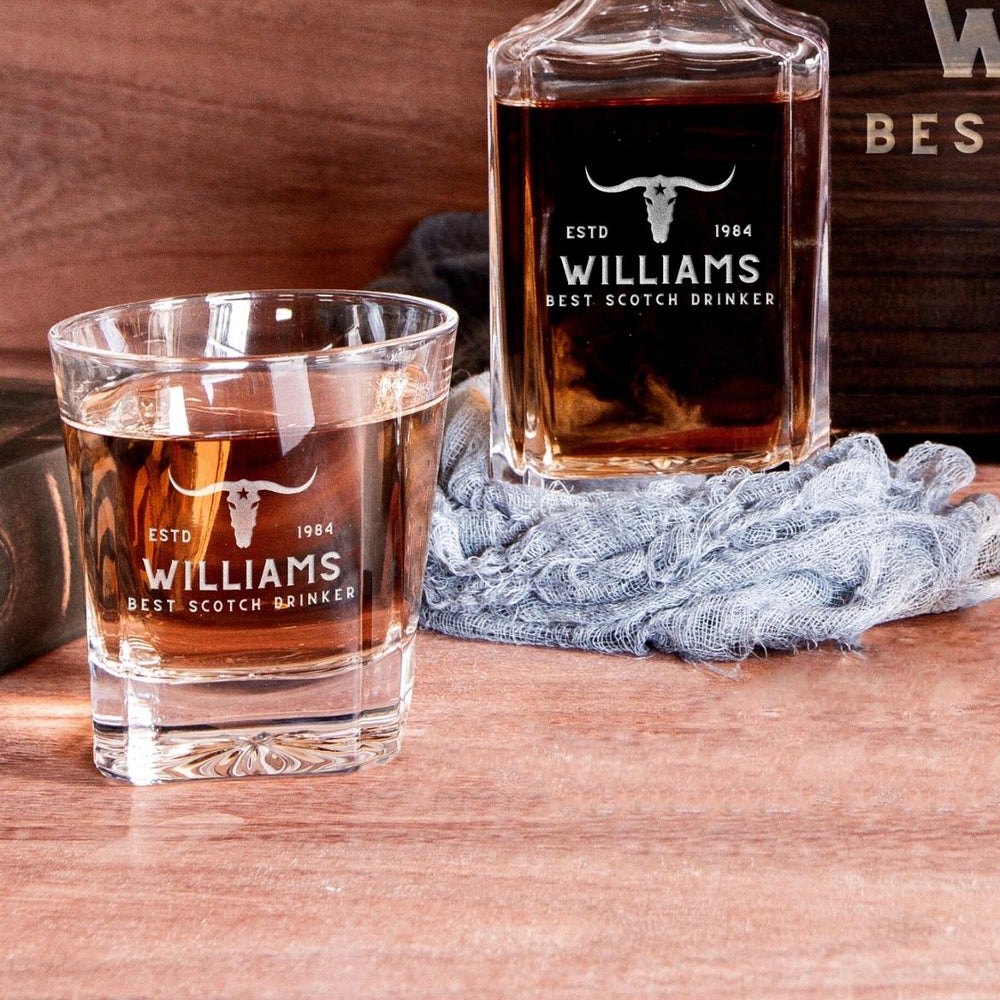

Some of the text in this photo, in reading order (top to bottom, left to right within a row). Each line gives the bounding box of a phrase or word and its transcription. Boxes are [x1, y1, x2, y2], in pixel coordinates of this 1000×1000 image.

[566, 225, 609, 239] ESTD
[714, 223, 752, 238] 1984
[559, 253, 761, 286] WILLIAMS
[545, 292, 775, 307] BEST SCOTCH DRINKER
[148, 528, 191, 543] ESTD
[297, 522, 334, 539] 1984
[142, 551, 342, 592] WILLIAMS
[127, 586, 356, 613] BEST SCOTCH DRINKER
